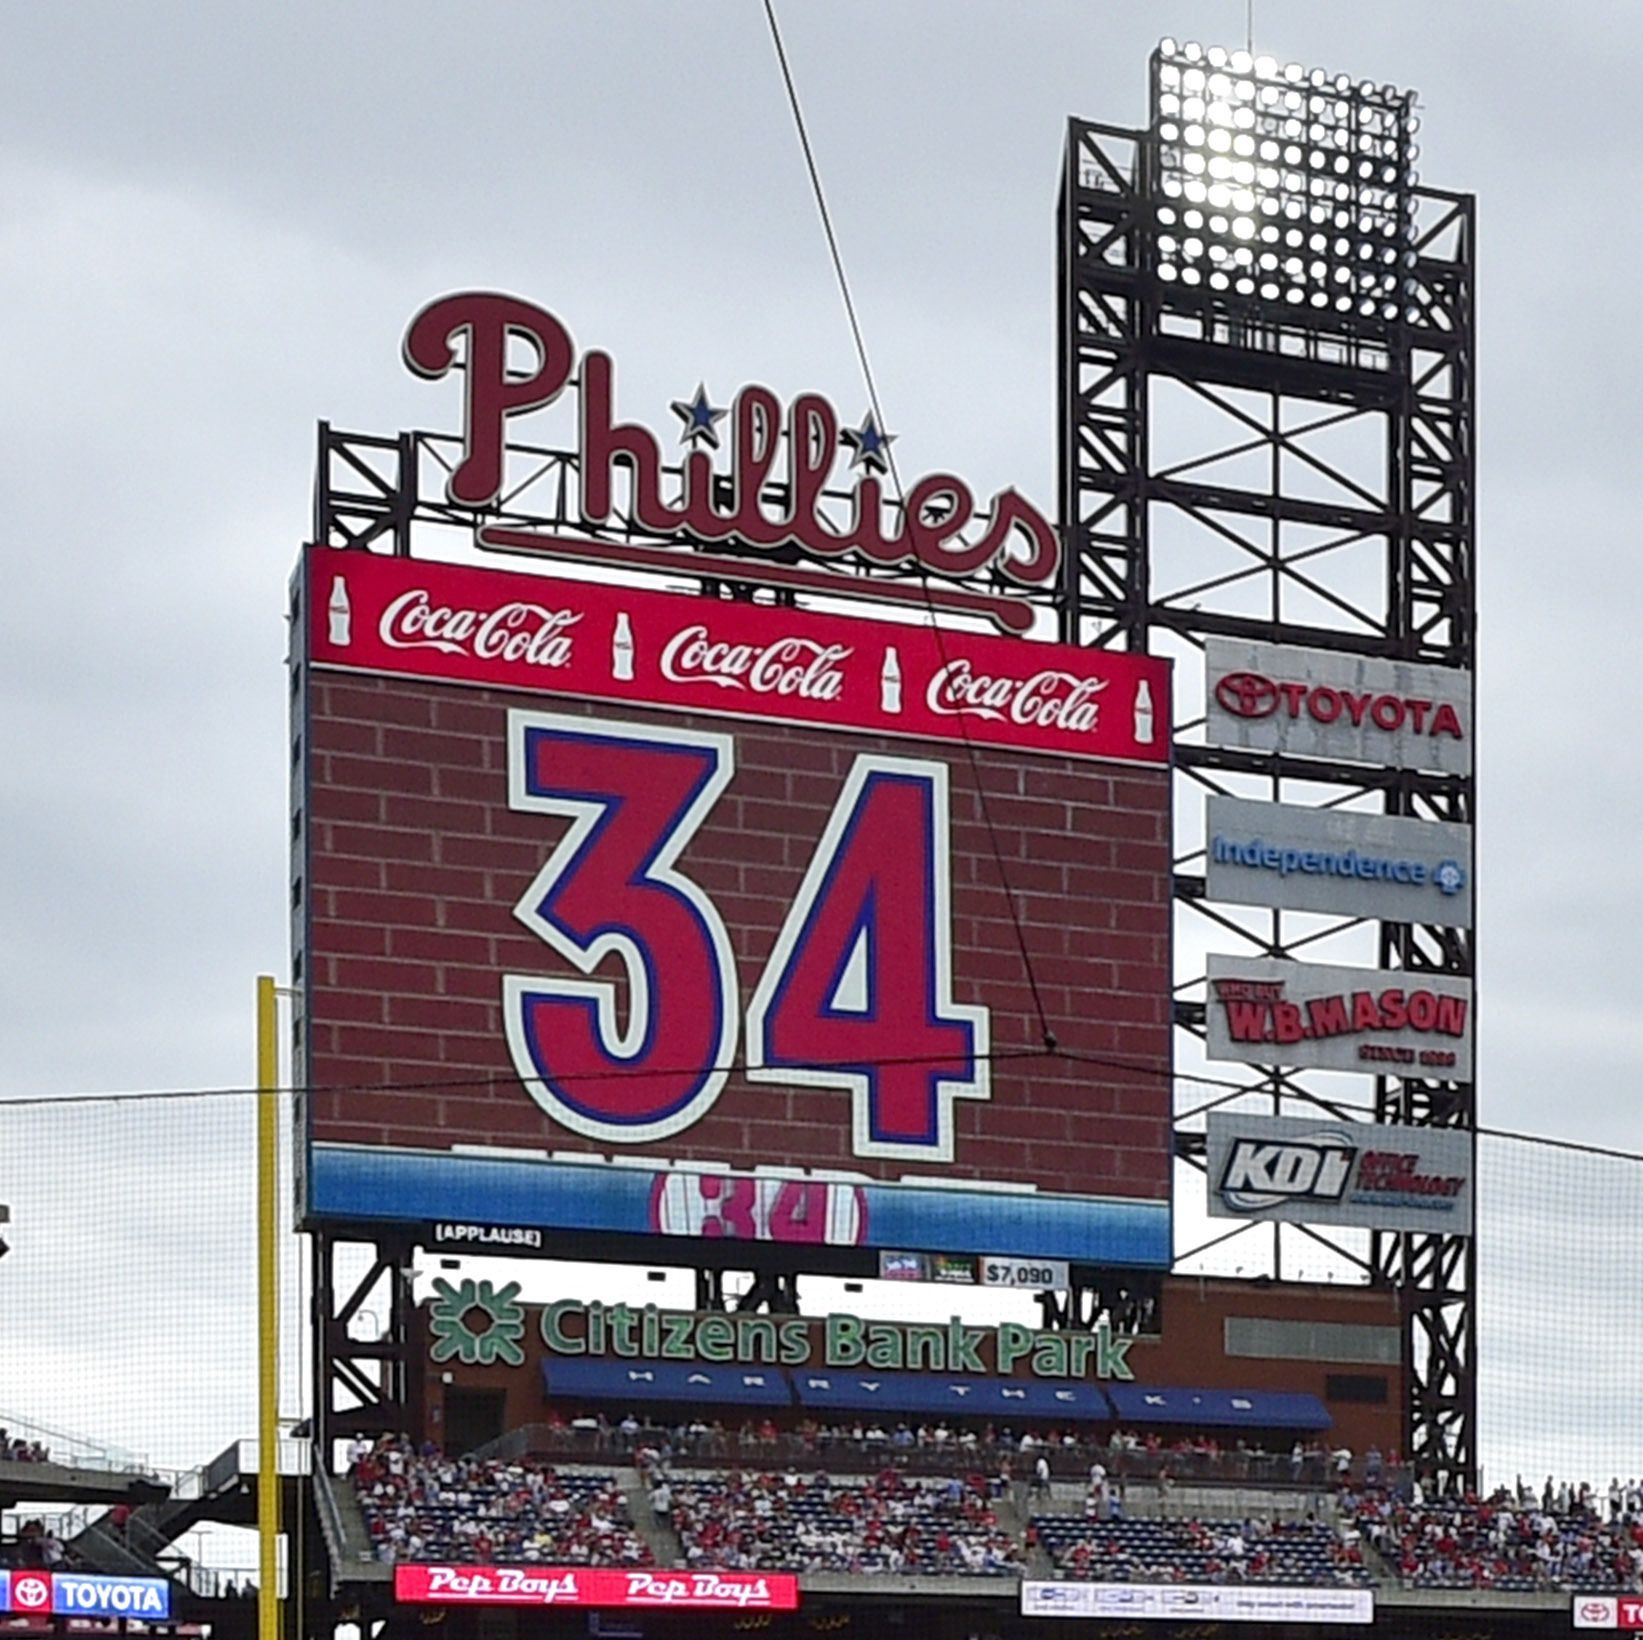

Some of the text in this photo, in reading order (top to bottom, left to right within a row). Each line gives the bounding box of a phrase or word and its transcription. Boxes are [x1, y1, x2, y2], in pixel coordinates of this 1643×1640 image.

[402, 290, 1060, 585] Phillies
[1277, 684, 1464, 738] TOYOTA
[1213, 836, 1426, 885] Independence
[503, 708, 991, 1163] 34
[1223, 1142, 1351, 1198] KDI
[436, 1223, 541, 1248] [APPLAUSE]
[987, 1263, 1054, 1287] $7,090
[541, 1299, 1136, 1381] Citizens Bank Park
[61, 1582, 163, 1611] TOYOTA
[427, 1567, 578, 1602] Pep Boys
[626, 1573, 770, 1605] Pep Boys
